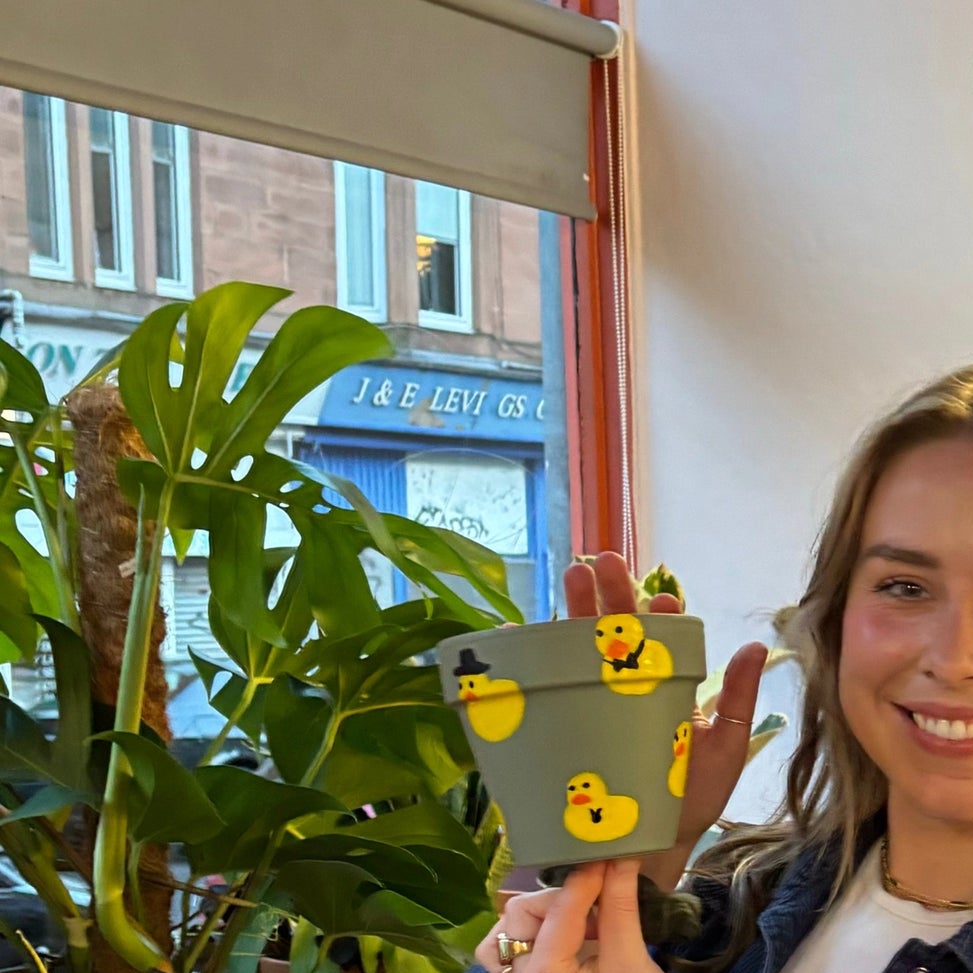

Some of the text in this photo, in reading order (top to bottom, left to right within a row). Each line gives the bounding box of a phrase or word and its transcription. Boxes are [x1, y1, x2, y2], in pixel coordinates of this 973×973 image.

[352, 376, 372, 405] J
[373, 378, 393, 407] &
[399, 382, 420, 409] E
[429, 386, 488, 416] LEVI
[497, 393, 528, 419] GS
